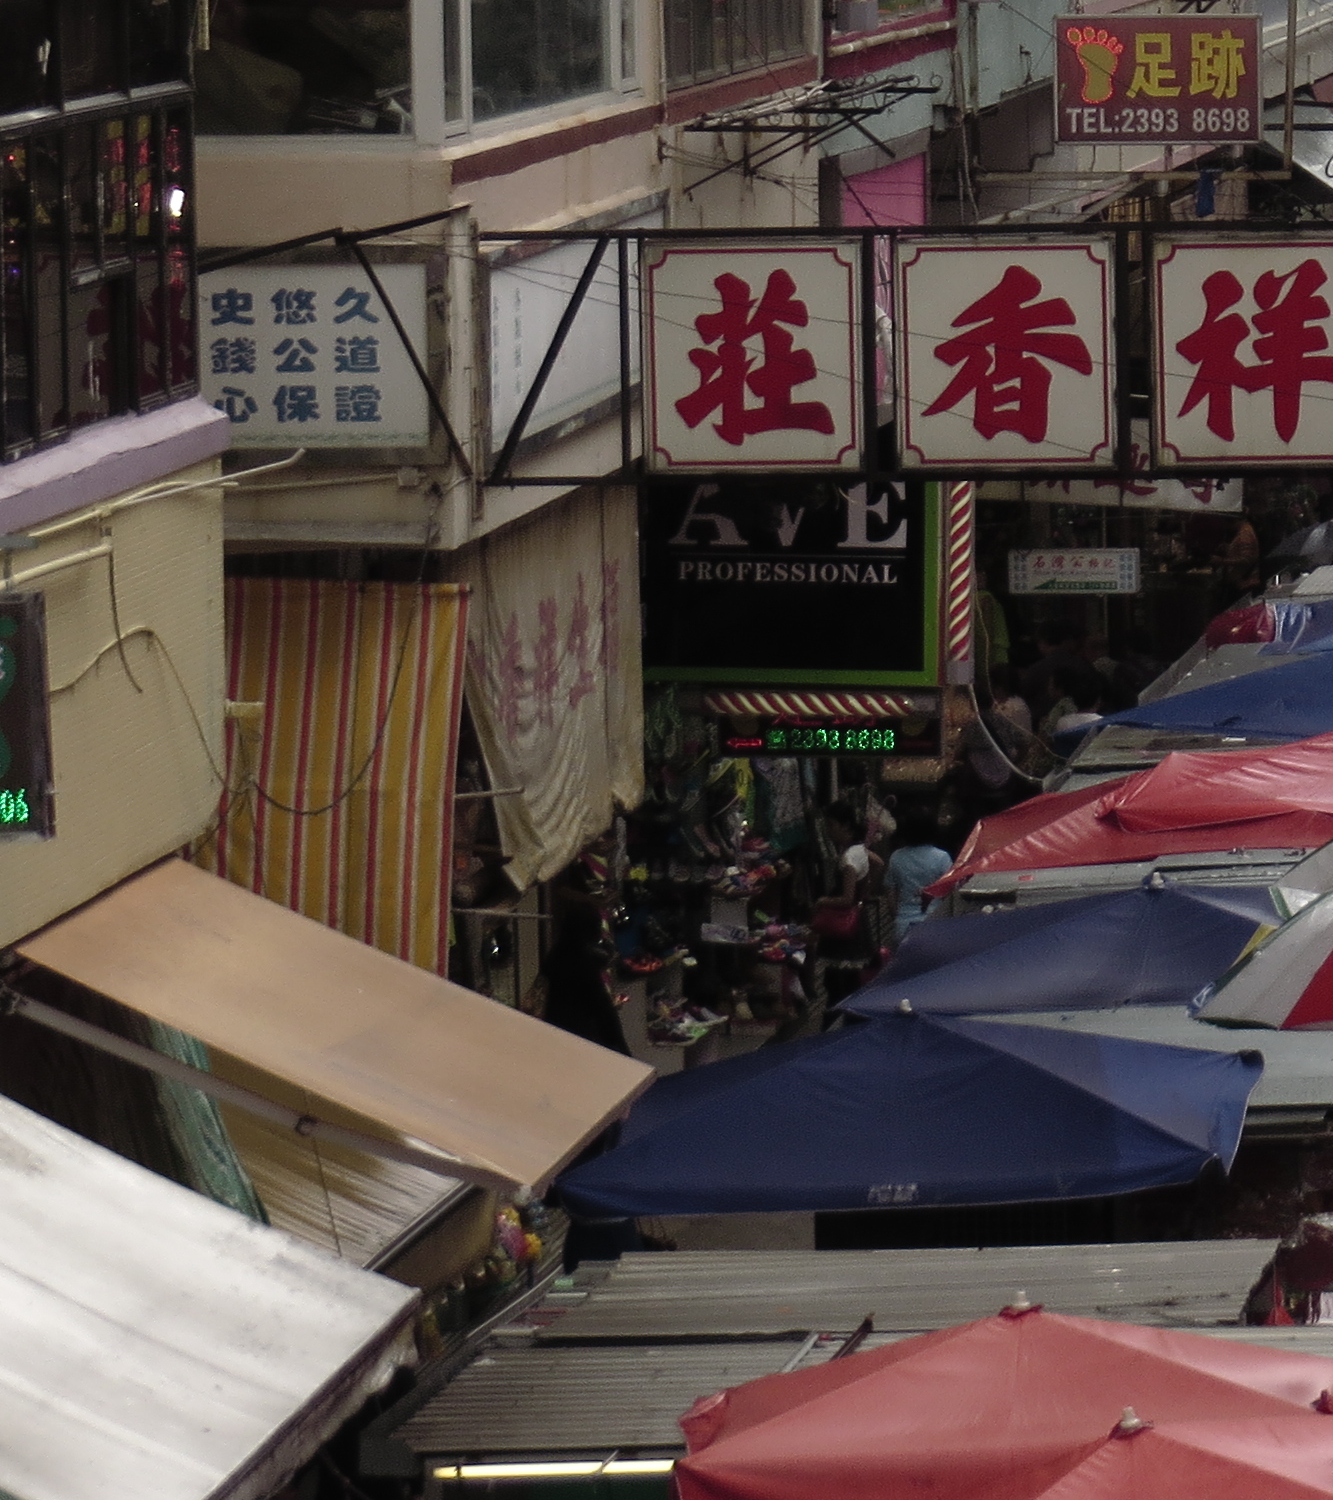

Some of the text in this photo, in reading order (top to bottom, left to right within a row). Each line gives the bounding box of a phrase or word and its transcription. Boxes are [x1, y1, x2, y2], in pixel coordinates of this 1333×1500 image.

[1125, 30, 1249, 100] 足跡
[1066, 106, 1251, 137] TEL:2393 8698
[678, 560, 899, 584] PROFESSIONAL
